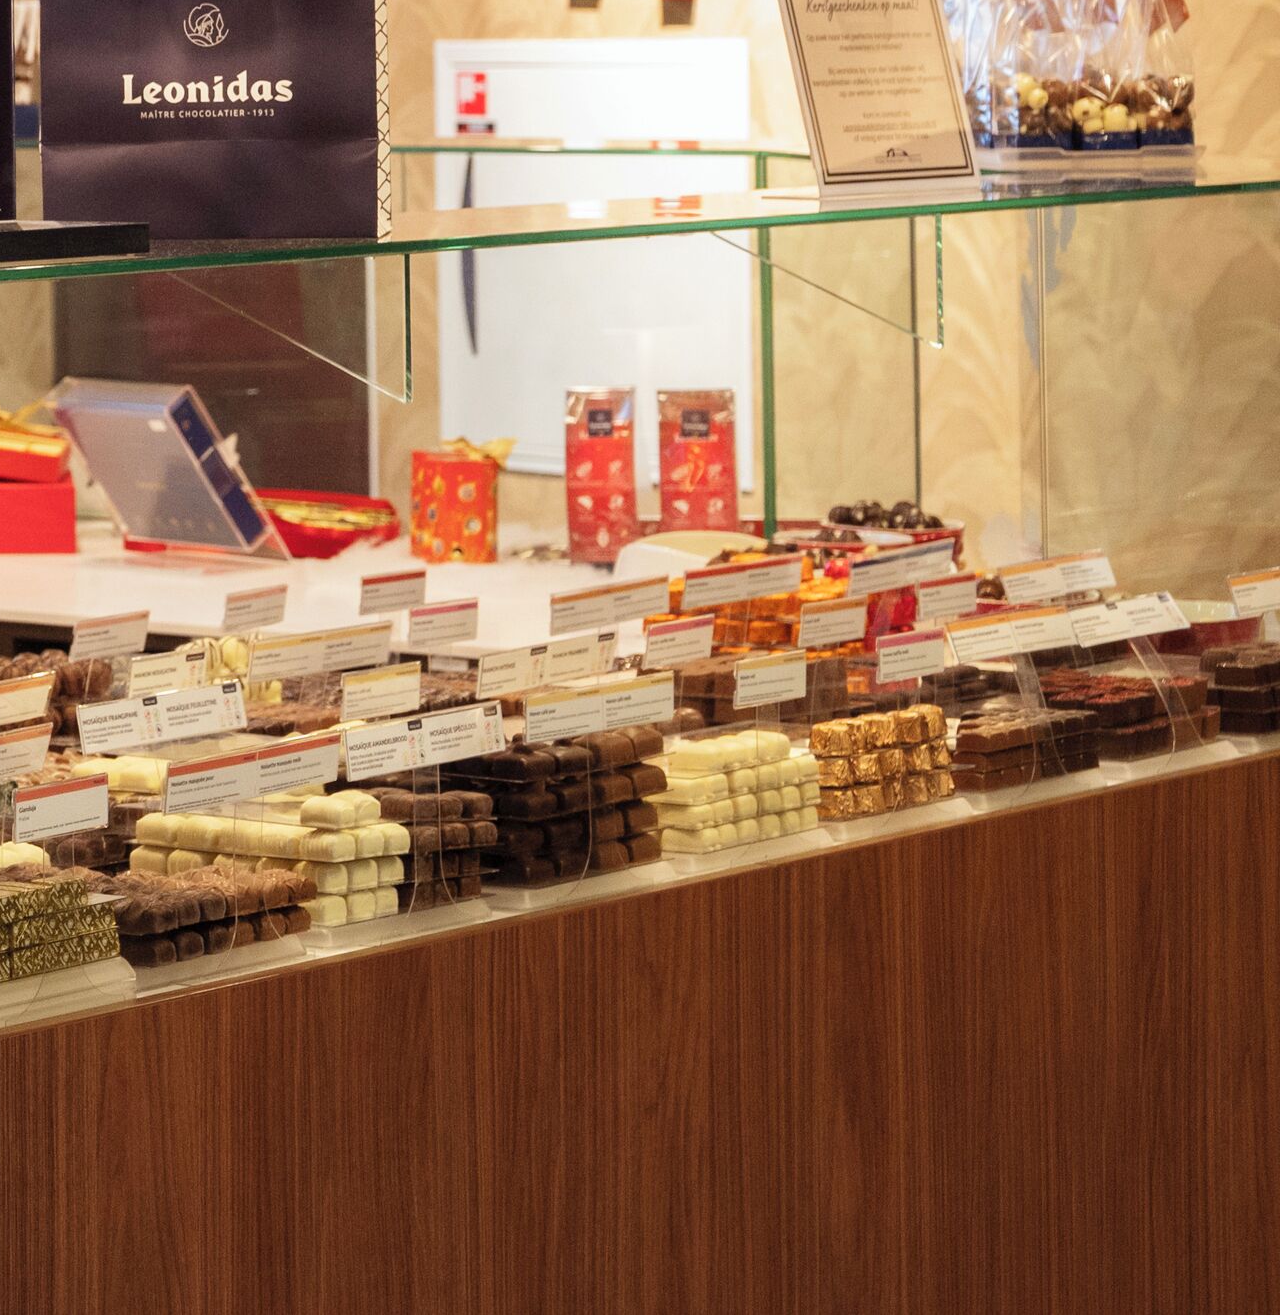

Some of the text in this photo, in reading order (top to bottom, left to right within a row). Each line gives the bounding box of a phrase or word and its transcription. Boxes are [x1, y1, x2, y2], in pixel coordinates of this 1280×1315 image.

[122, 70, 293, 105] Leonidas
[140, 108, 275, 119] MAÎTRE CHOCOLATIER 1913
[18, 804, 37, 815] Gianduja
